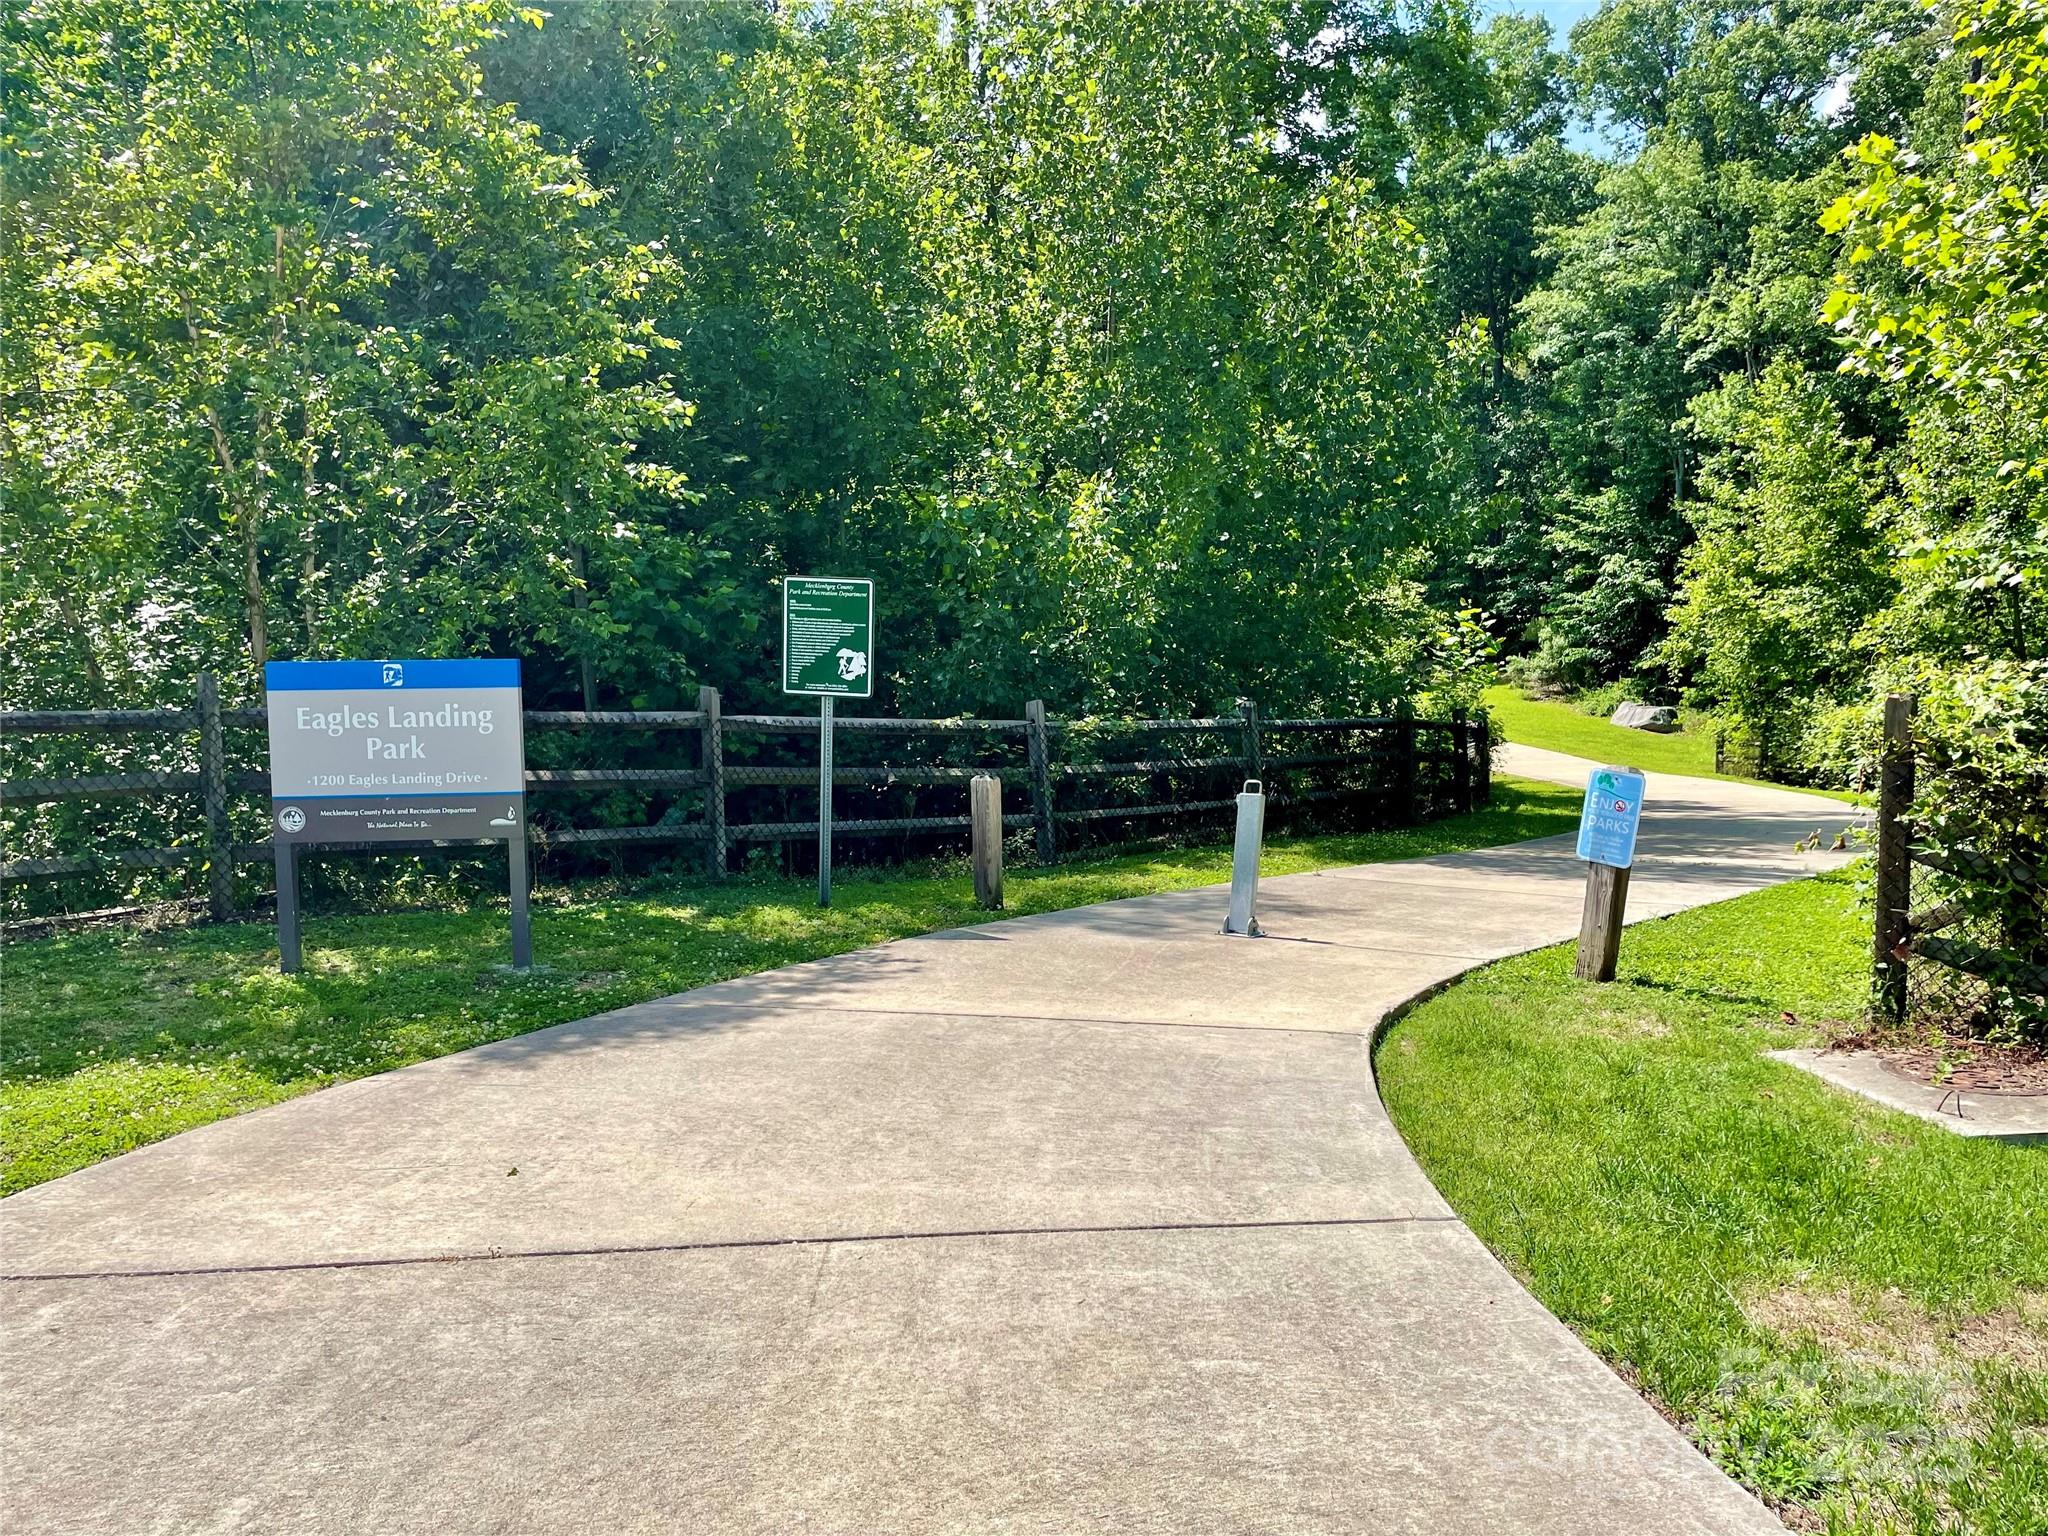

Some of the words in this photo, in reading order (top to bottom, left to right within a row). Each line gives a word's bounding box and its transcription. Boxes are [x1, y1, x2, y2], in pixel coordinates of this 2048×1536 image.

[296, 704, 379, 737] Eagles
[388, 703, 493, 735] Landing
[366, 735, 426, 760] Park
[349, 772, 388, 788] Eagles
[392, 771, 443, 787] Landing
[446, 771, 481, 783] Drive
[320, 808, 359, 817] Mecklenburg
[409, 807, 440, 815] Recreation
[442, 807, 477, 815] Department
[1587, 814, 1630, 834] PARKS
